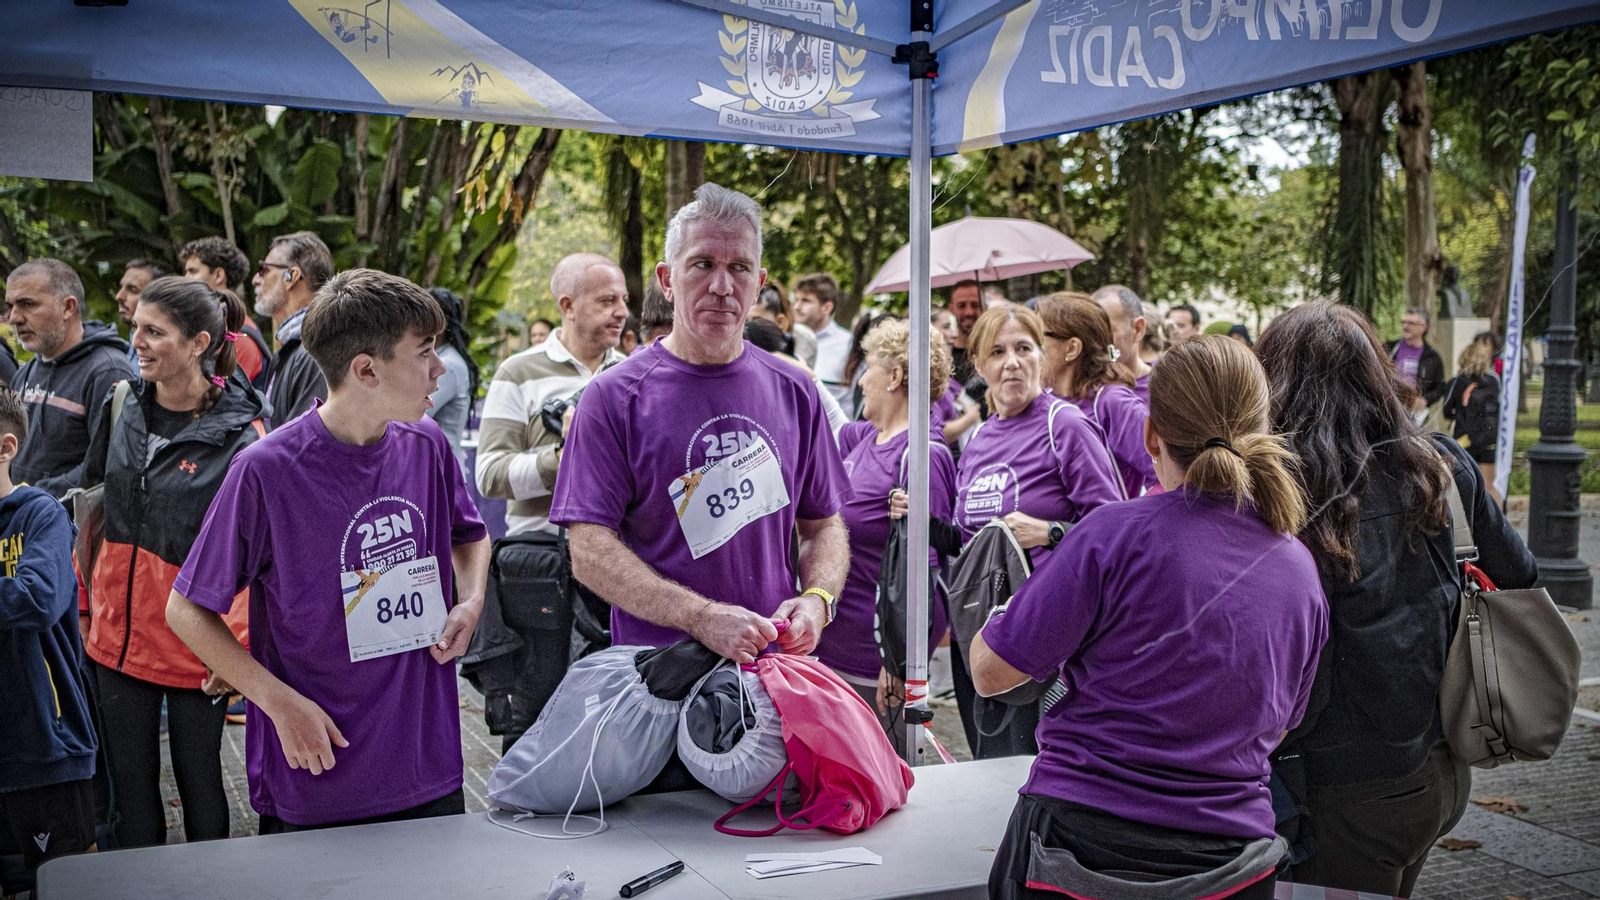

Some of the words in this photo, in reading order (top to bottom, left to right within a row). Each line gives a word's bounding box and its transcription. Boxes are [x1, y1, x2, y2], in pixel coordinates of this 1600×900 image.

[686, 428, 702, 468] INTERNACIONAL
[701, 416, 720, 429] CONTRA
[728, 413, 756, 425] VIOLENCIA
[756, 423, 769, 437] HACIA
[732, 444, 766, 468] CARRERA
[706, 478, 755, 519] 839
[968, 472, 1008, 492] 25N
[340, 519, 356, 565] INTERNACIONAL
[354, 502, 373, 519] CONTRA
[405, 500, 419, 512] HACIA
[357, 509, 413, 550] 25N
[386, 555, 395, 565] 21
[395, 551, 405, 561] 21
[404, 547, 415, 558] 30
[408, 564, 435, 575] CARRERA
[376, 591, 424, 624] 840
